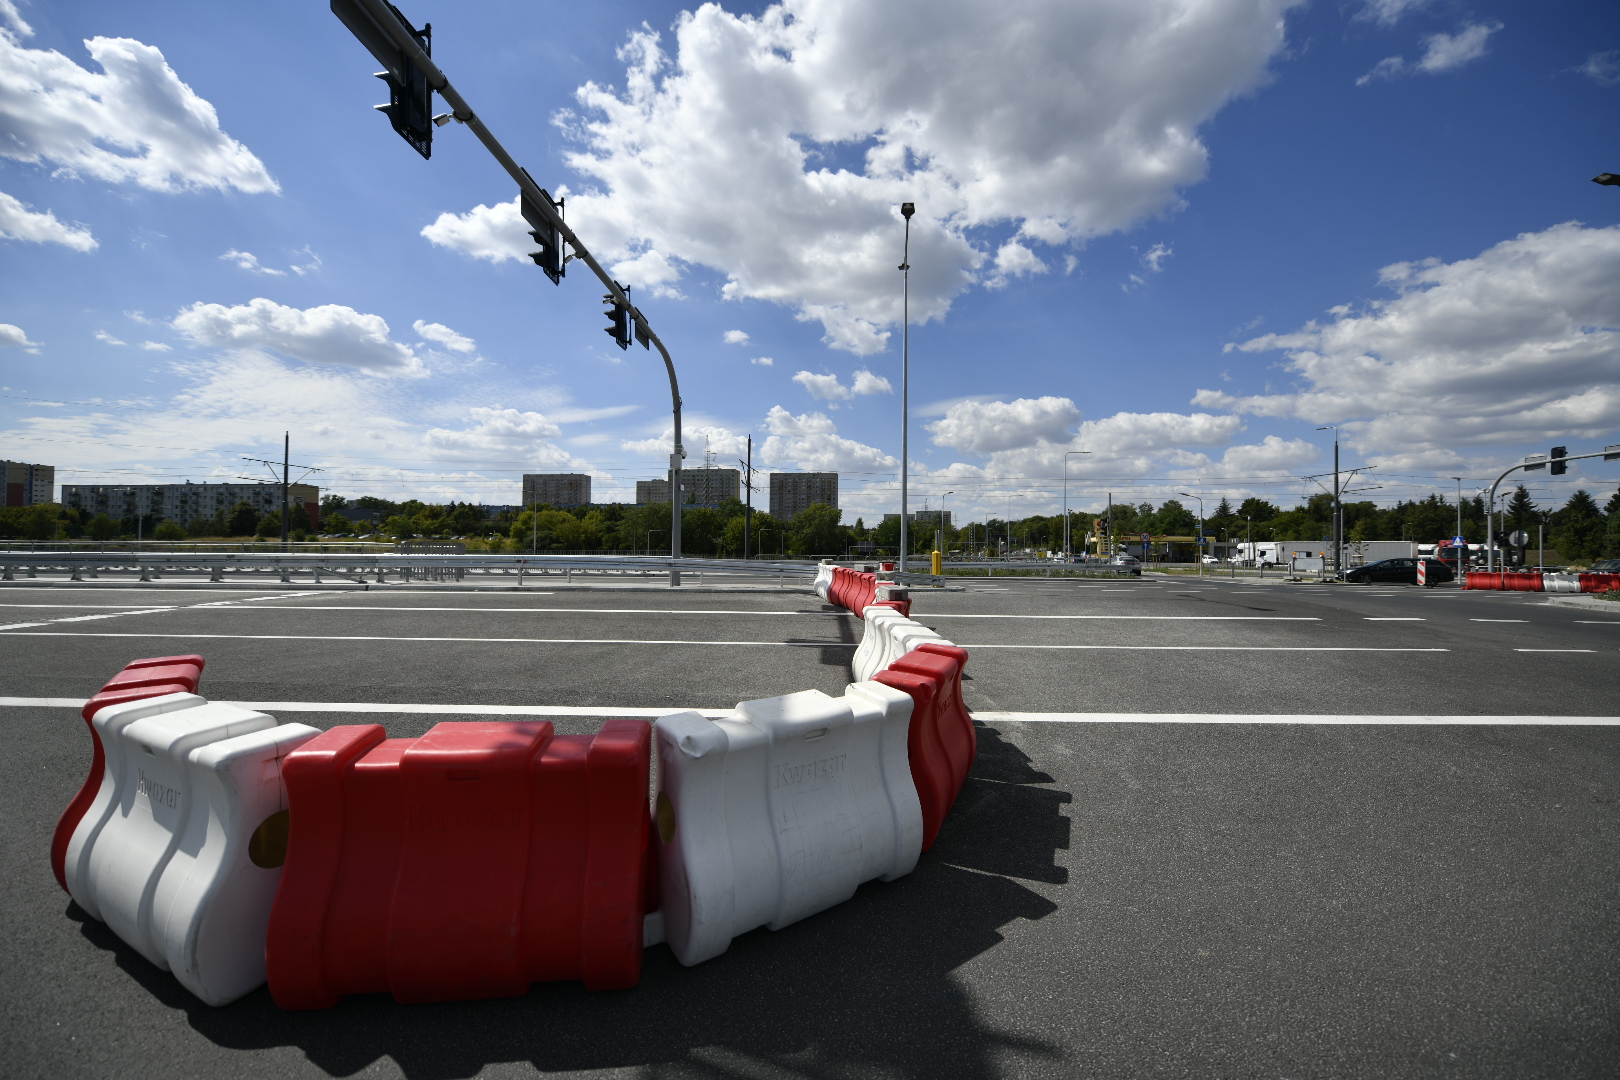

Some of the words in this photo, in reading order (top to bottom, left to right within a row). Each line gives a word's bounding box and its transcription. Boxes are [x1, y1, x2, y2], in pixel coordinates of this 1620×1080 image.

[137, 767, 181, 809] Kwazar
[773, 753, 847, 788] Kwazar
[408, 803, 525, 833] Kwazar
